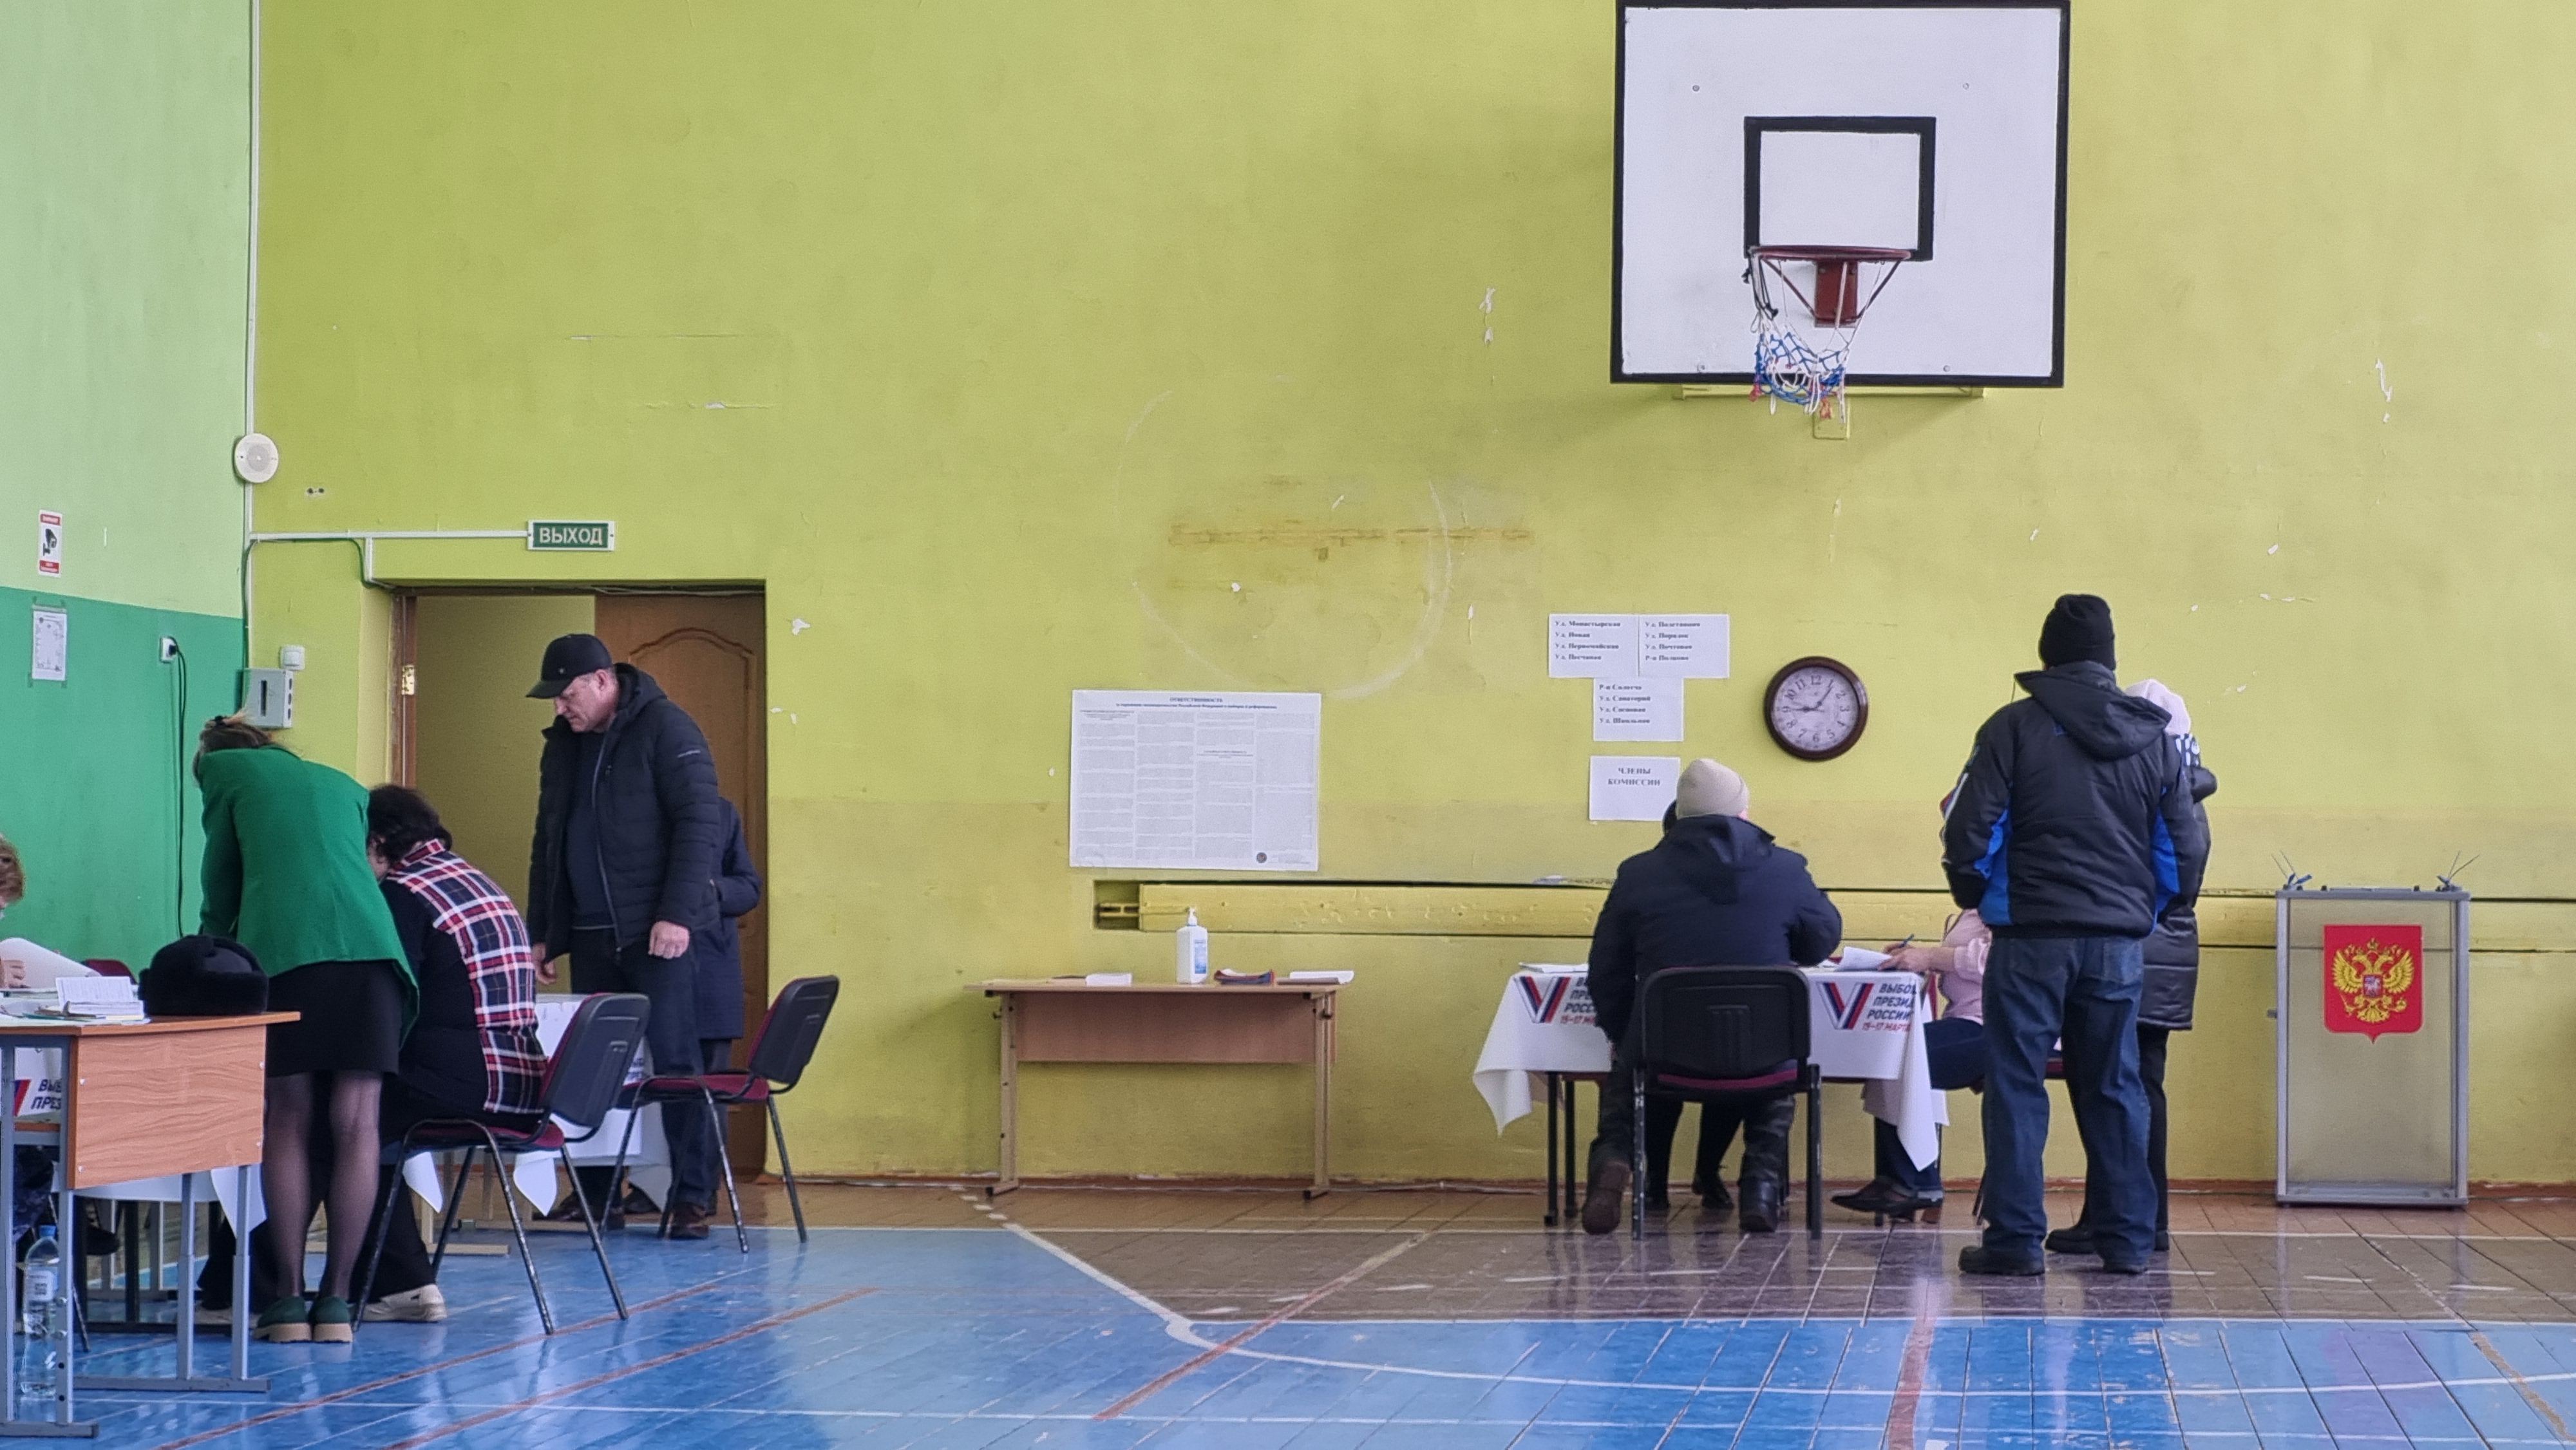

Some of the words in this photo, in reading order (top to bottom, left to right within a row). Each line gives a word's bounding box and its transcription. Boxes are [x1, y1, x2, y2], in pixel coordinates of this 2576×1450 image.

[539, 527, 603, 545] ВЫХОД
[1795, 679, 1807, 690] 11
[1810, 675, 1821, 685] 12
[1785, 689, 1797, 701] 10
[1835, 690, 1846, 699] 2
[1786, 719, 1798, 728] 8
[1798, 728, 1808, 738] 7
[1813, 733, 1820, 742] 6
[1826, 729, 1835, 739] 5
[1564, 1002, 1595, 1013] РОСС
